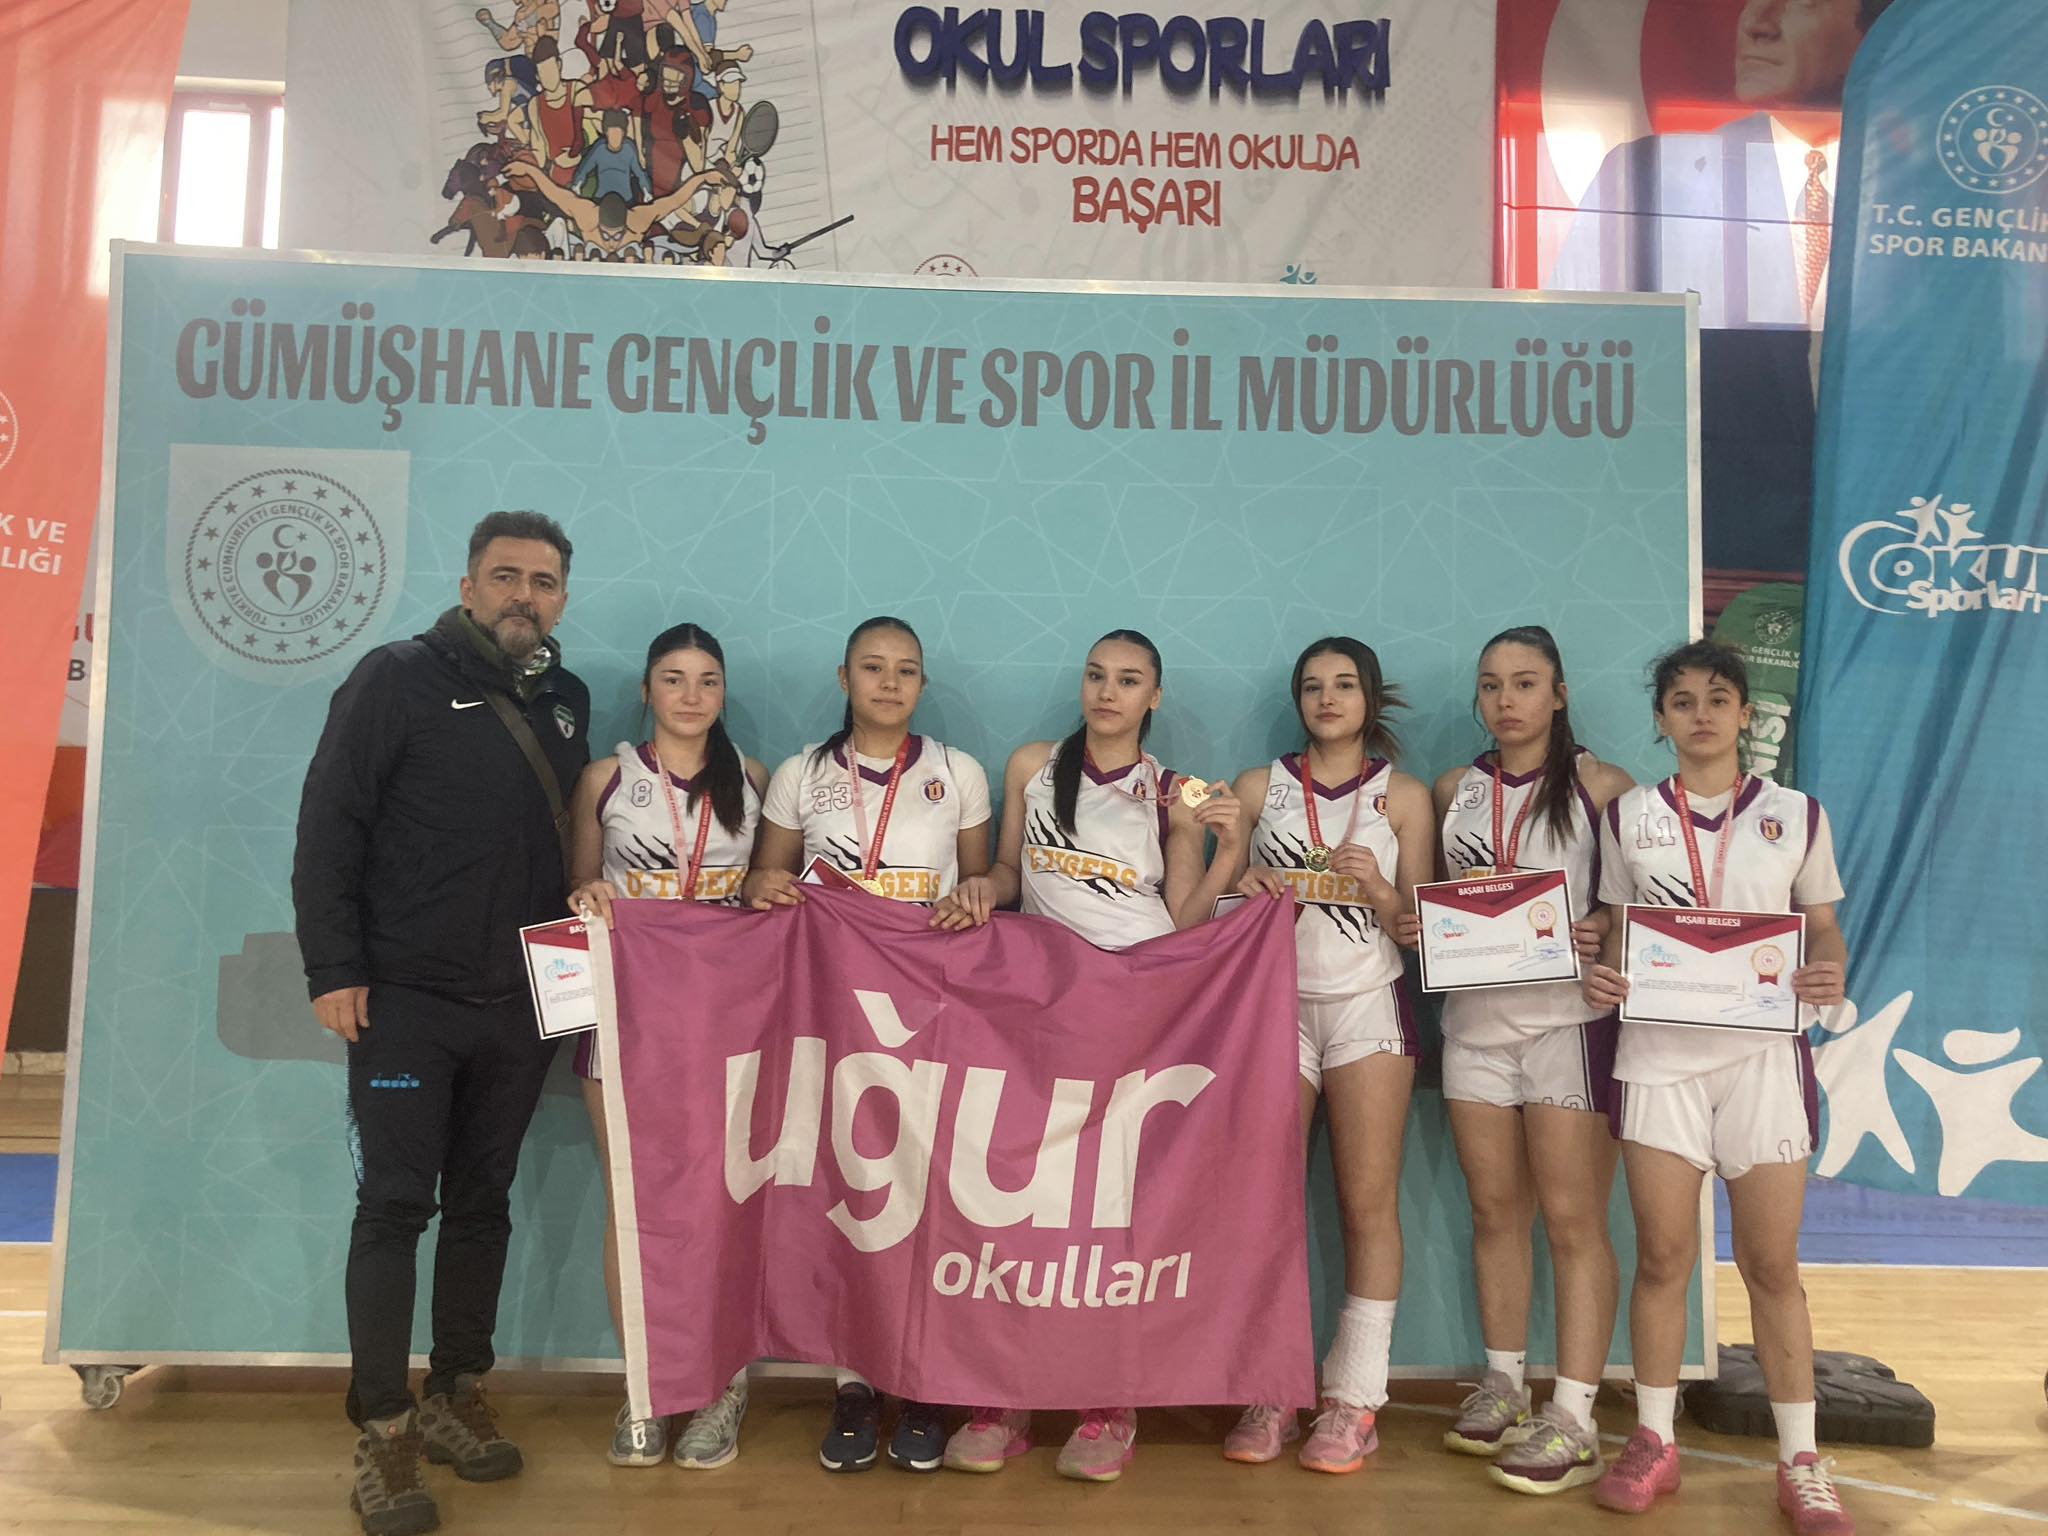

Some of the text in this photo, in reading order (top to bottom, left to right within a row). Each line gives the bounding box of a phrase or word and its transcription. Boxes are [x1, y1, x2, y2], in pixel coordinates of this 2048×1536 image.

[894, 5, 1392, 96] OKUL SPORLARI
[931, 124, 1360, 171] HEM SPORDA HEM OKULDA
[1072, 175, 1221, 233] BAŞARI
[1871, 203, 1922, 227] T.C.
[1869, 233, 1945, 257] SPOR
[175, 298, 1635, 446] GÜMÜŞHANE GENÇLİK VE SPOR İL MÜDÜRLÜĞÜ
[270, 503, 323, 523] GENÇLİK
[323, 520, 339, 535] VE
[27, 517, 67, 544] VE
[222, 506, 269, 583] CUMHURİYETİ
[333, 535, 351, 572] SPOR
[301, 572, 351, 626] BAKANLIĞI
[631, 779, 653, 808] 8
[811, 781, 853, 814] 23
[1270, 783, 1290, 810] 7
[1636, 813, 1676, 849] 11
[1458, 881, 1514, 897] BAŞARI BELGESİ
[1675, 914, 1741, 927] BAŞARI BELGESİ
[724, 988, 1217, 1253] uğur
[932, 1241, 1192, 1310] okulları
